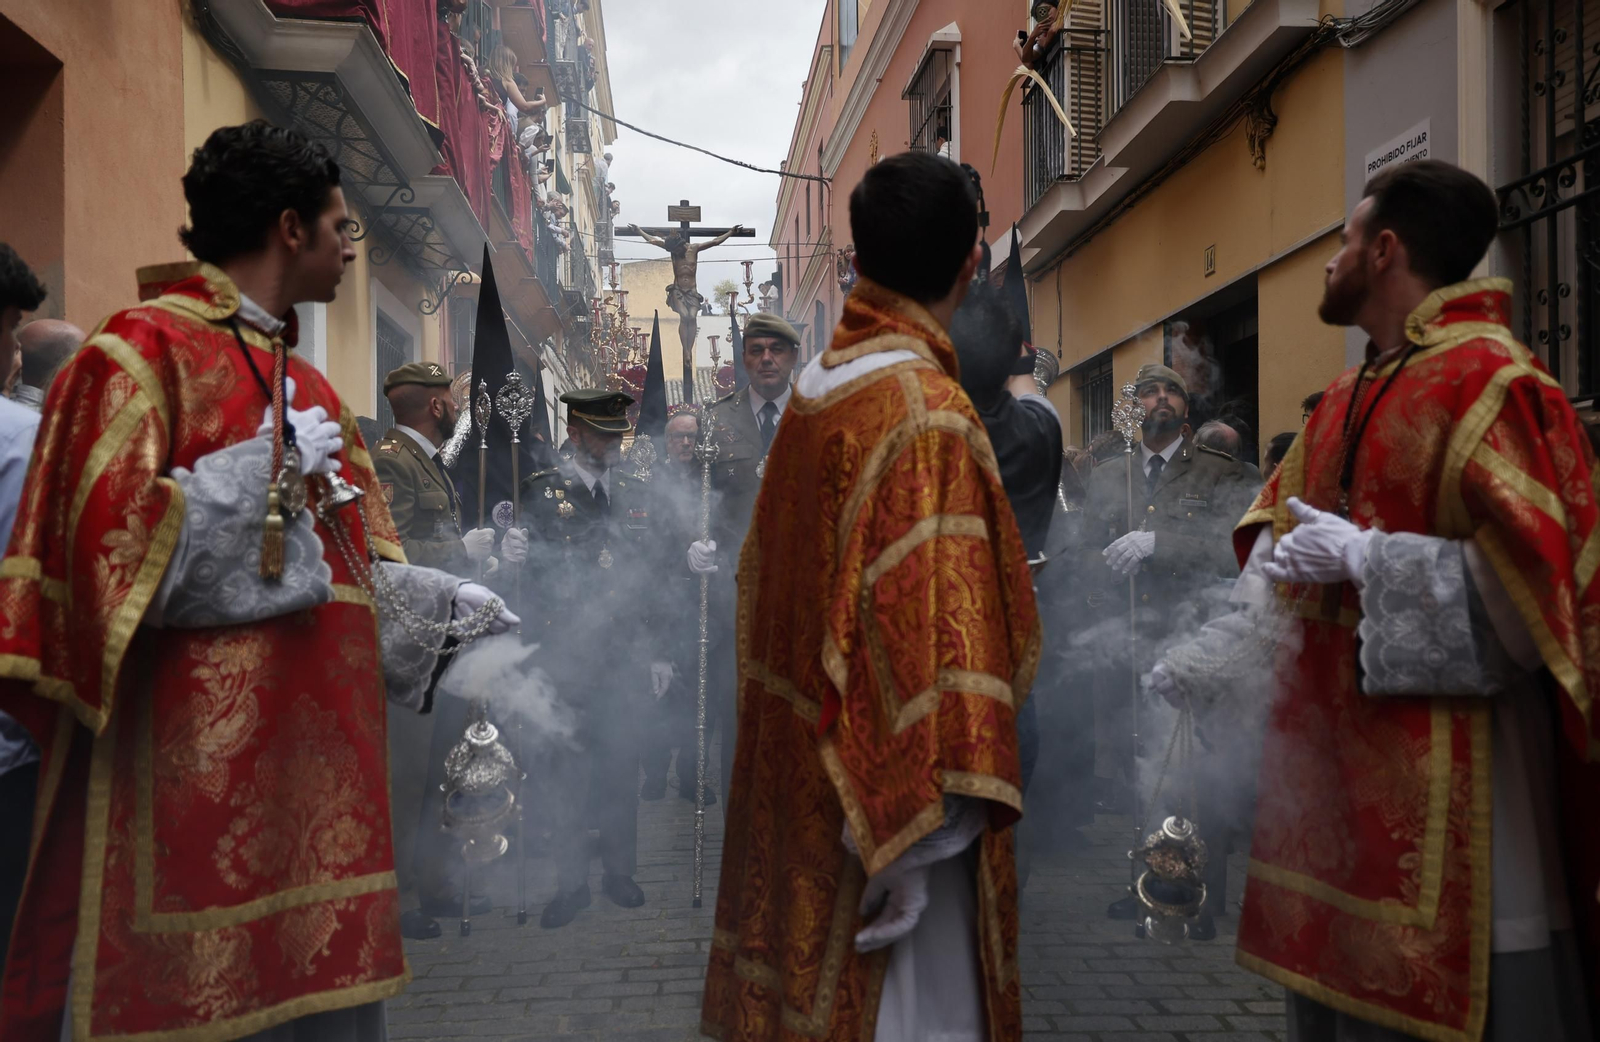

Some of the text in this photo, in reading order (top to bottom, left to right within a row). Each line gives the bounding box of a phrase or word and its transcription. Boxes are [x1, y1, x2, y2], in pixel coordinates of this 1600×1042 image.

[1367, 131, 1427, 174] PROHIBIDO FIJAR
[1399, 149, 1428, 165] MENTO
[1206, 249, 1213, 271] 14
